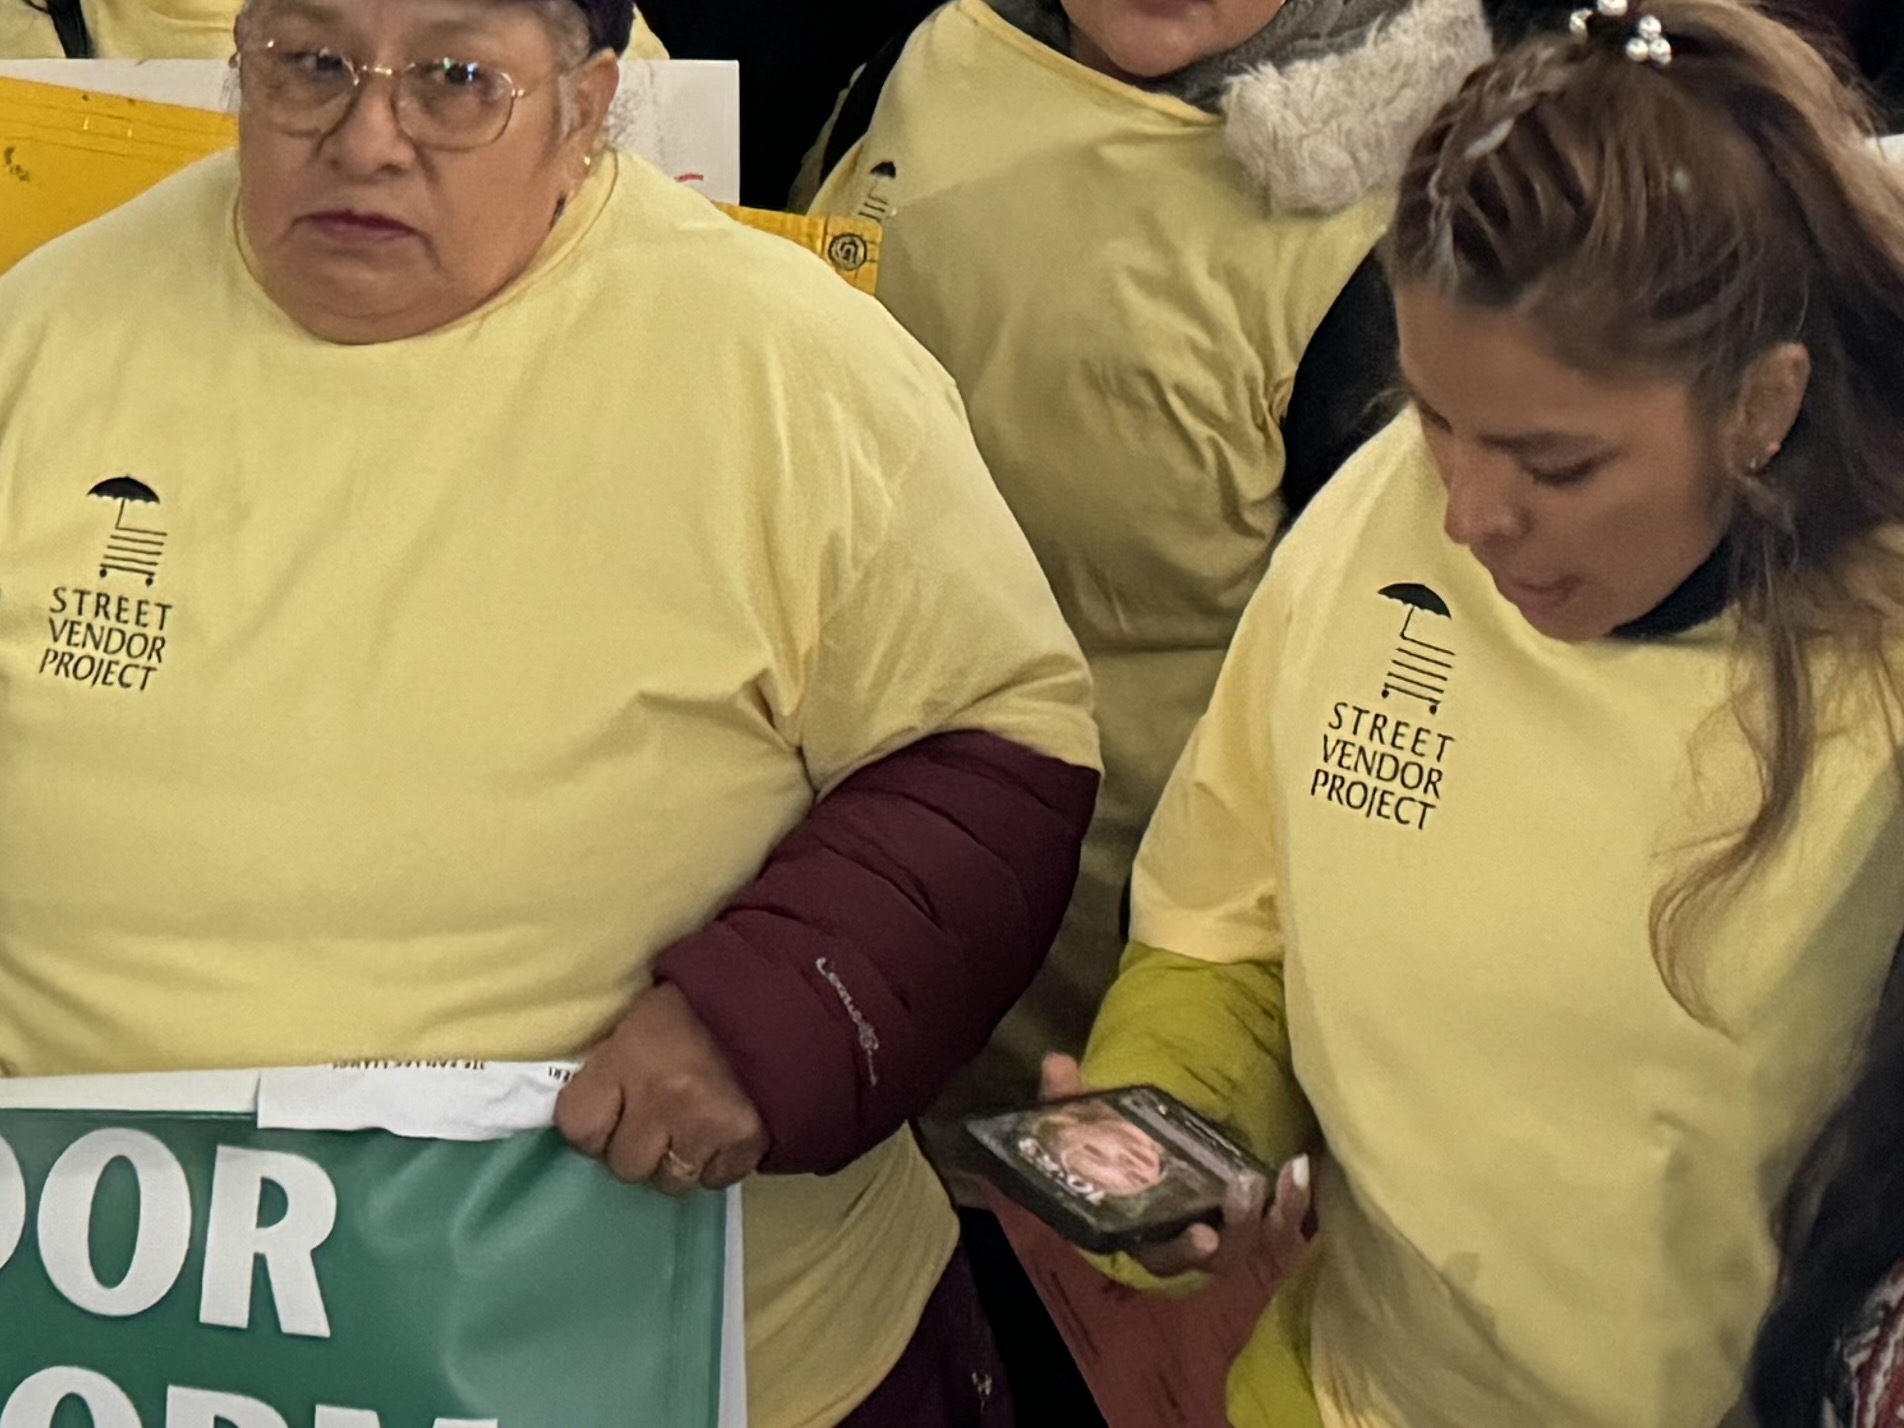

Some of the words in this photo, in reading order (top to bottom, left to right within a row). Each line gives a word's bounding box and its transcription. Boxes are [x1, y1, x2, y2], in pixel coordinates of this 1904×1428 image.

[49, 585, 173, 632] STREET
[47, 616, 167, 664] VENDOR
[38, 647, 157, 692] PROJECT
[1327, 701, 1456, 763] STREET
[1322, 733, 1444, 799] VENDOR
[1310, 768, 1437, 831] PROJECT
